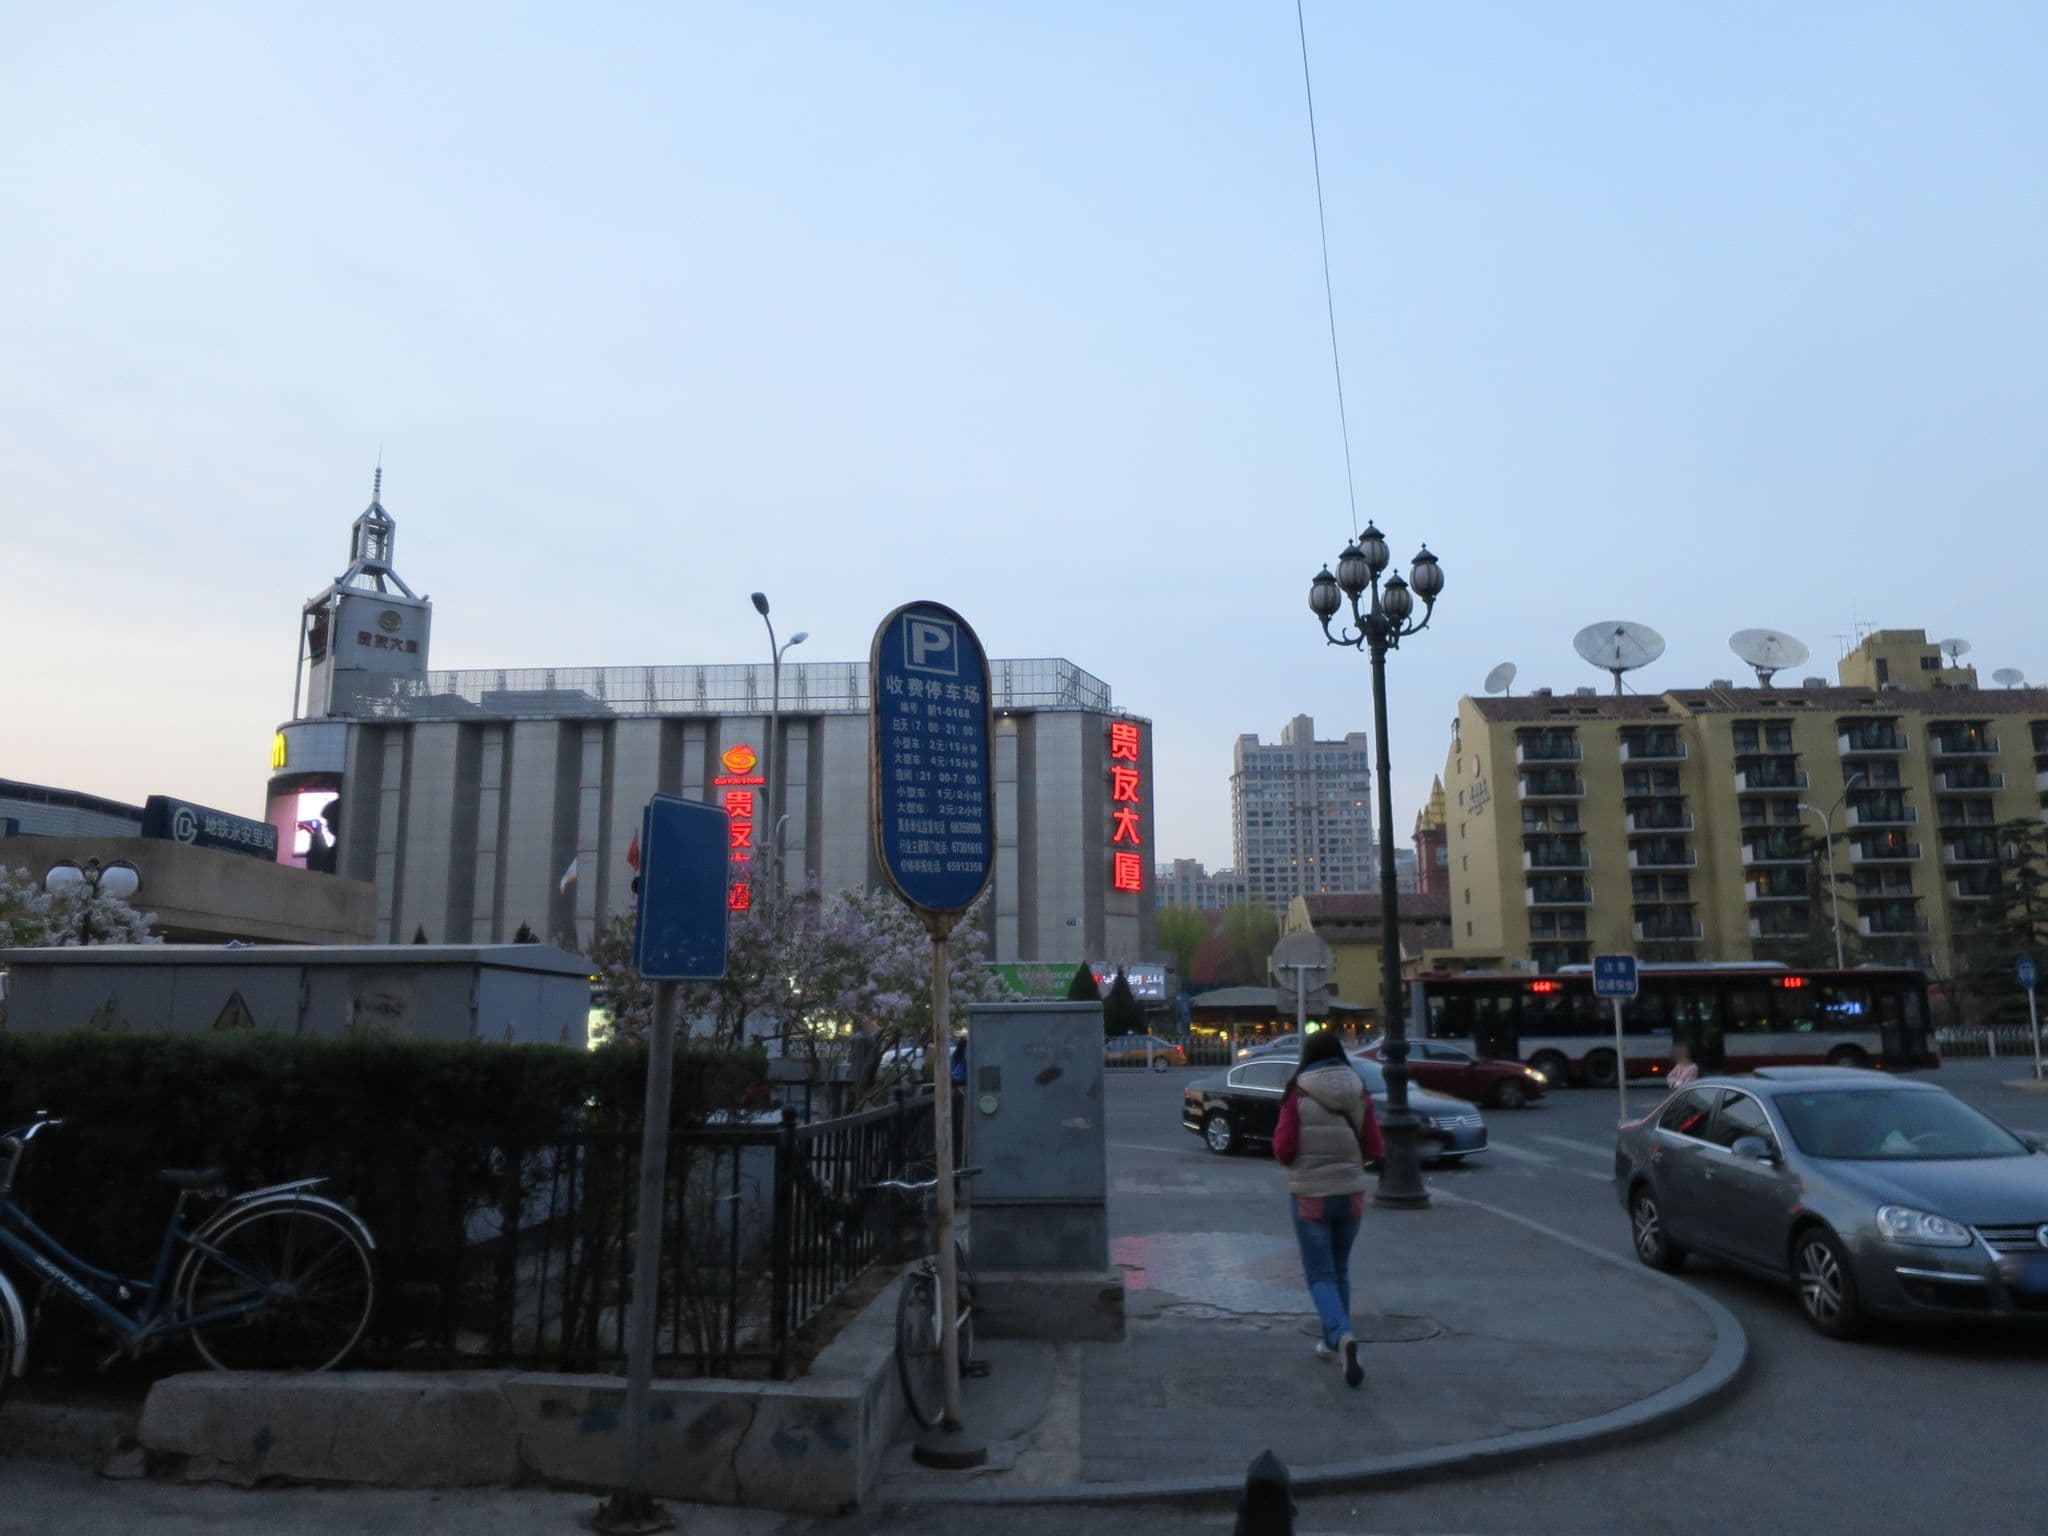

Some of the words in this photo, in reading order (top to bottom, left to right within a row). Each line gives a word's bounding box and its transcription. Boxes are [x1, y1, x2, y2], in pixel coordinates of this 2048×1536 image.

[911, 621, 951, 665] P
[885, 675, 981, 704] 收费停车场
[1111, 722, 1142, 891] 贵友大厦
[204, 816, 275, 850] 地铁永安里站
